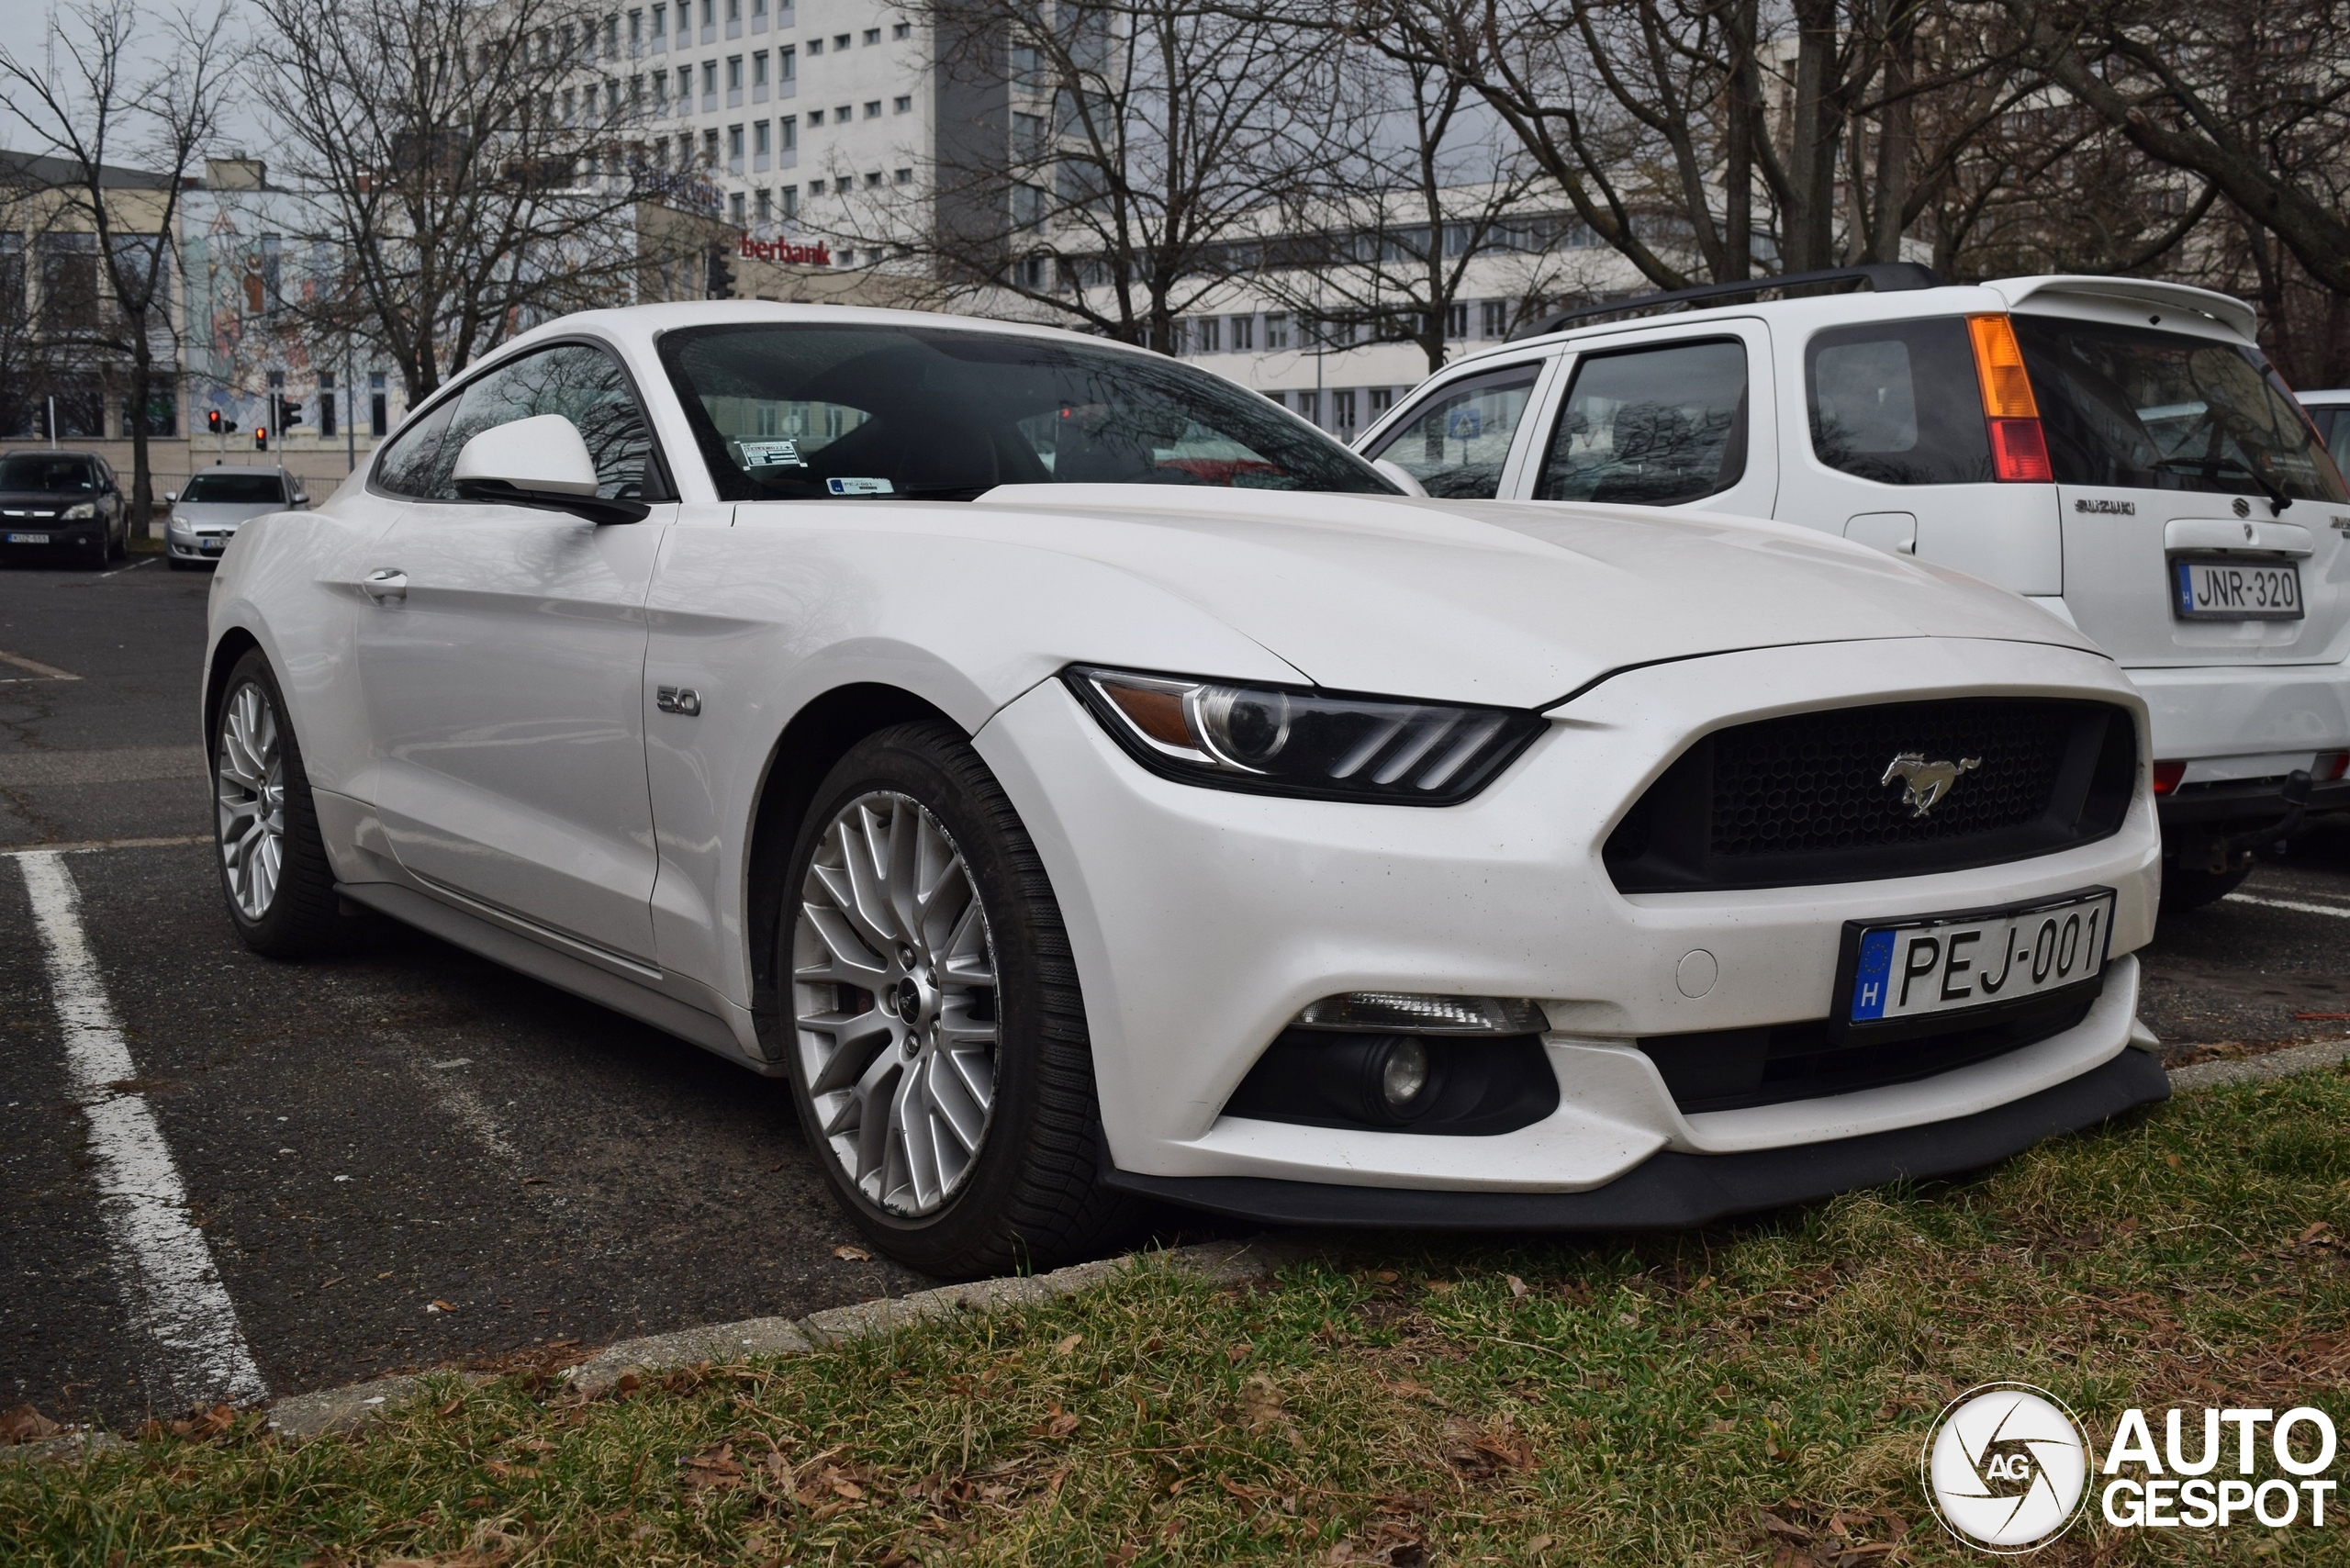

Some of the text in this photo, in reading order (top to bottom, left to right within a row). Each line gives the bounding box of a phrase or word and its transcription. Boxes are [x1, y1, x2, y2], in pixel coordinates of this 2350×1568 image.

[737, 232, 831, 265] berbank
[2075, 499, 2135, 516] SUZUKI
[2182, 569, 2294, 608] H JNR-320
[656, 685, 702, 717] 5.0
[1861, 906, 2100, 1008] H PEJ-001
